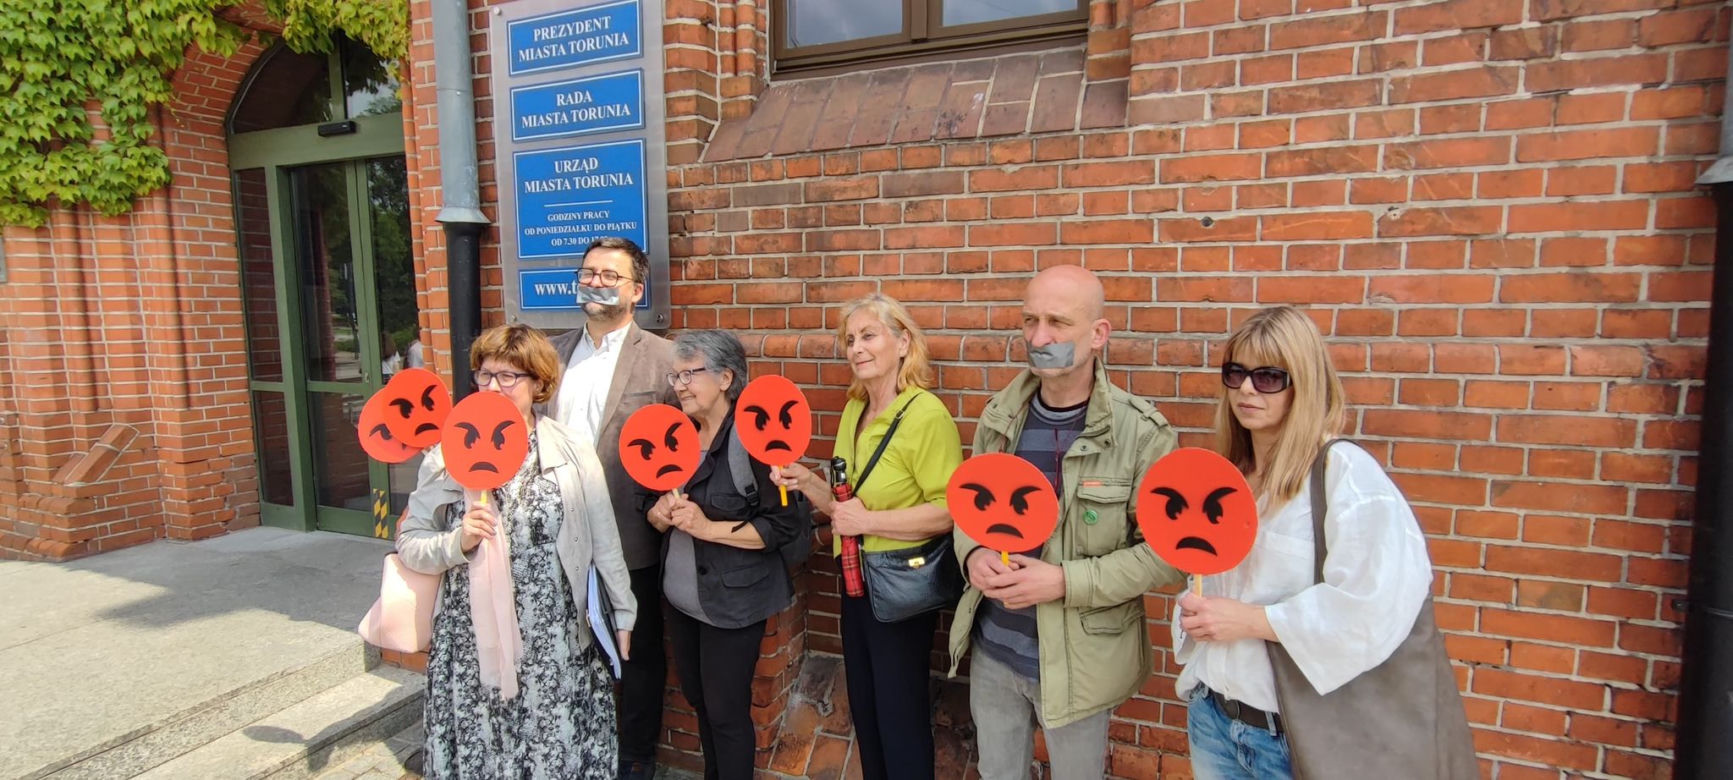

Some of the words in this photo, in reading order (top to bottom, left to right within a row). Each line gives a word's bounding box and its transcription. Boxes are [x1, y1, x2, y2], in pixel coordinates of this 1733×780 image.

[533, 16, 611, 42] PREZYDENT
[519, 44, 566, 62] MIASTA
[568, 32, 629, 54] TORUNIA
[556, 90, 592, 107] RADA
[522, 112, 568, 129] MIASTA
[570, 104, 631, 123] TORUNIA
[554, 157, 598, 173] URZĄD
[524, 178, 571, 193] MIASTA
[573, 173, 633, 189] TORUNIA
[547, 212, 581, 221] GODZINY
[583, 210, 610, 219] PRACY
[524, 228, 535, 236] OD
[536, 224, 593, 235] PONIEDZIAŁKU
[594, 223, 606, 231] DO
[607, 221, 637, 231] PIĄTKU
[551, 238, 562, 246] OD
[563, 237, 577, 245] 7.30
[578, 236, 590, 245] DO
[534, 280, 577, 296] www.t
